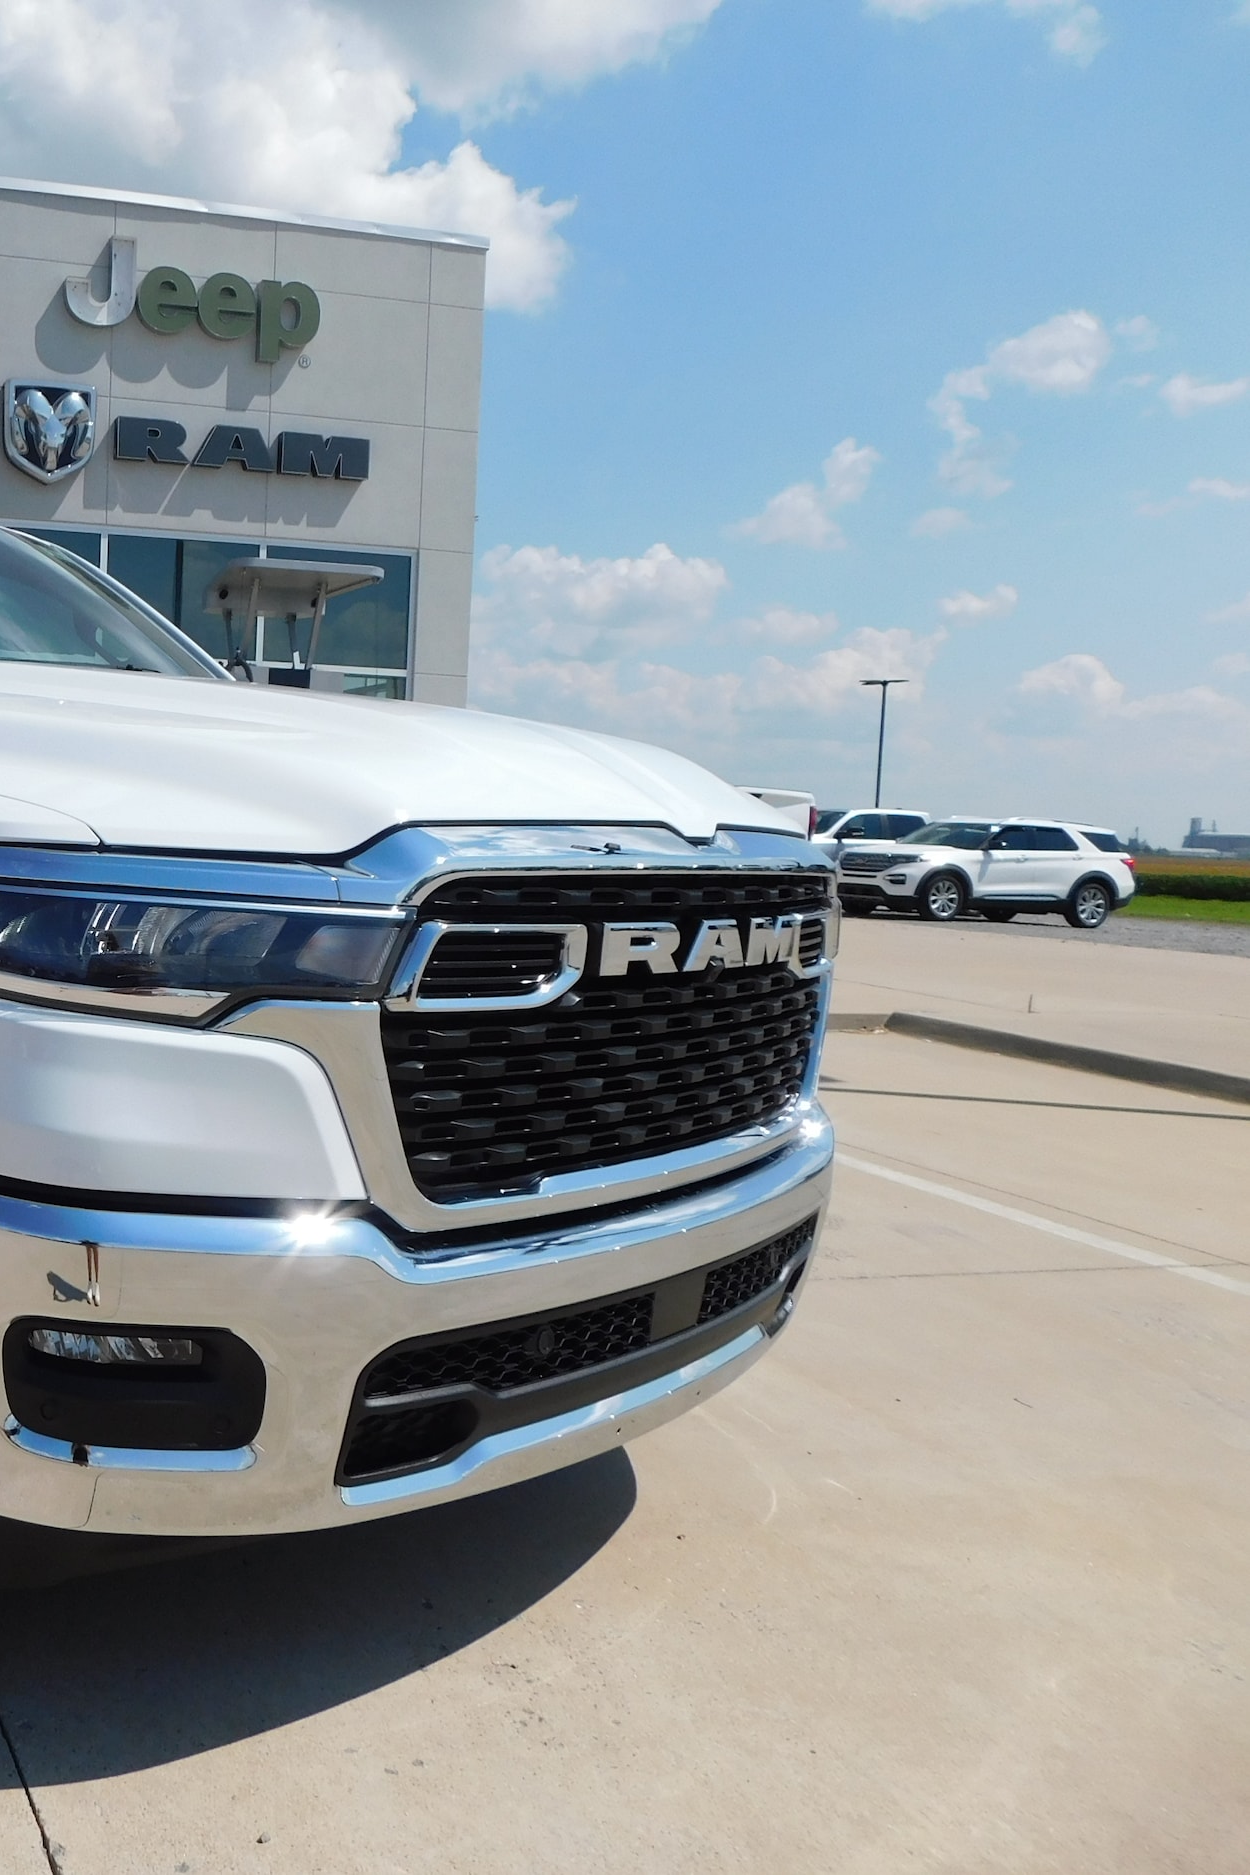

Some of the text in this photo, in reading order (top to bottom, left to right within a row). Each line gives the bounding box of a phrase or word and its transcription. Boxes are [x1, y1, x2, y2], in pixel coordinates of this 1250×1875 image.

[64, 235, 321, 363] Jeep
[113, 415, 371, 481] RAM
[599, 913, 797, 977] RAM
